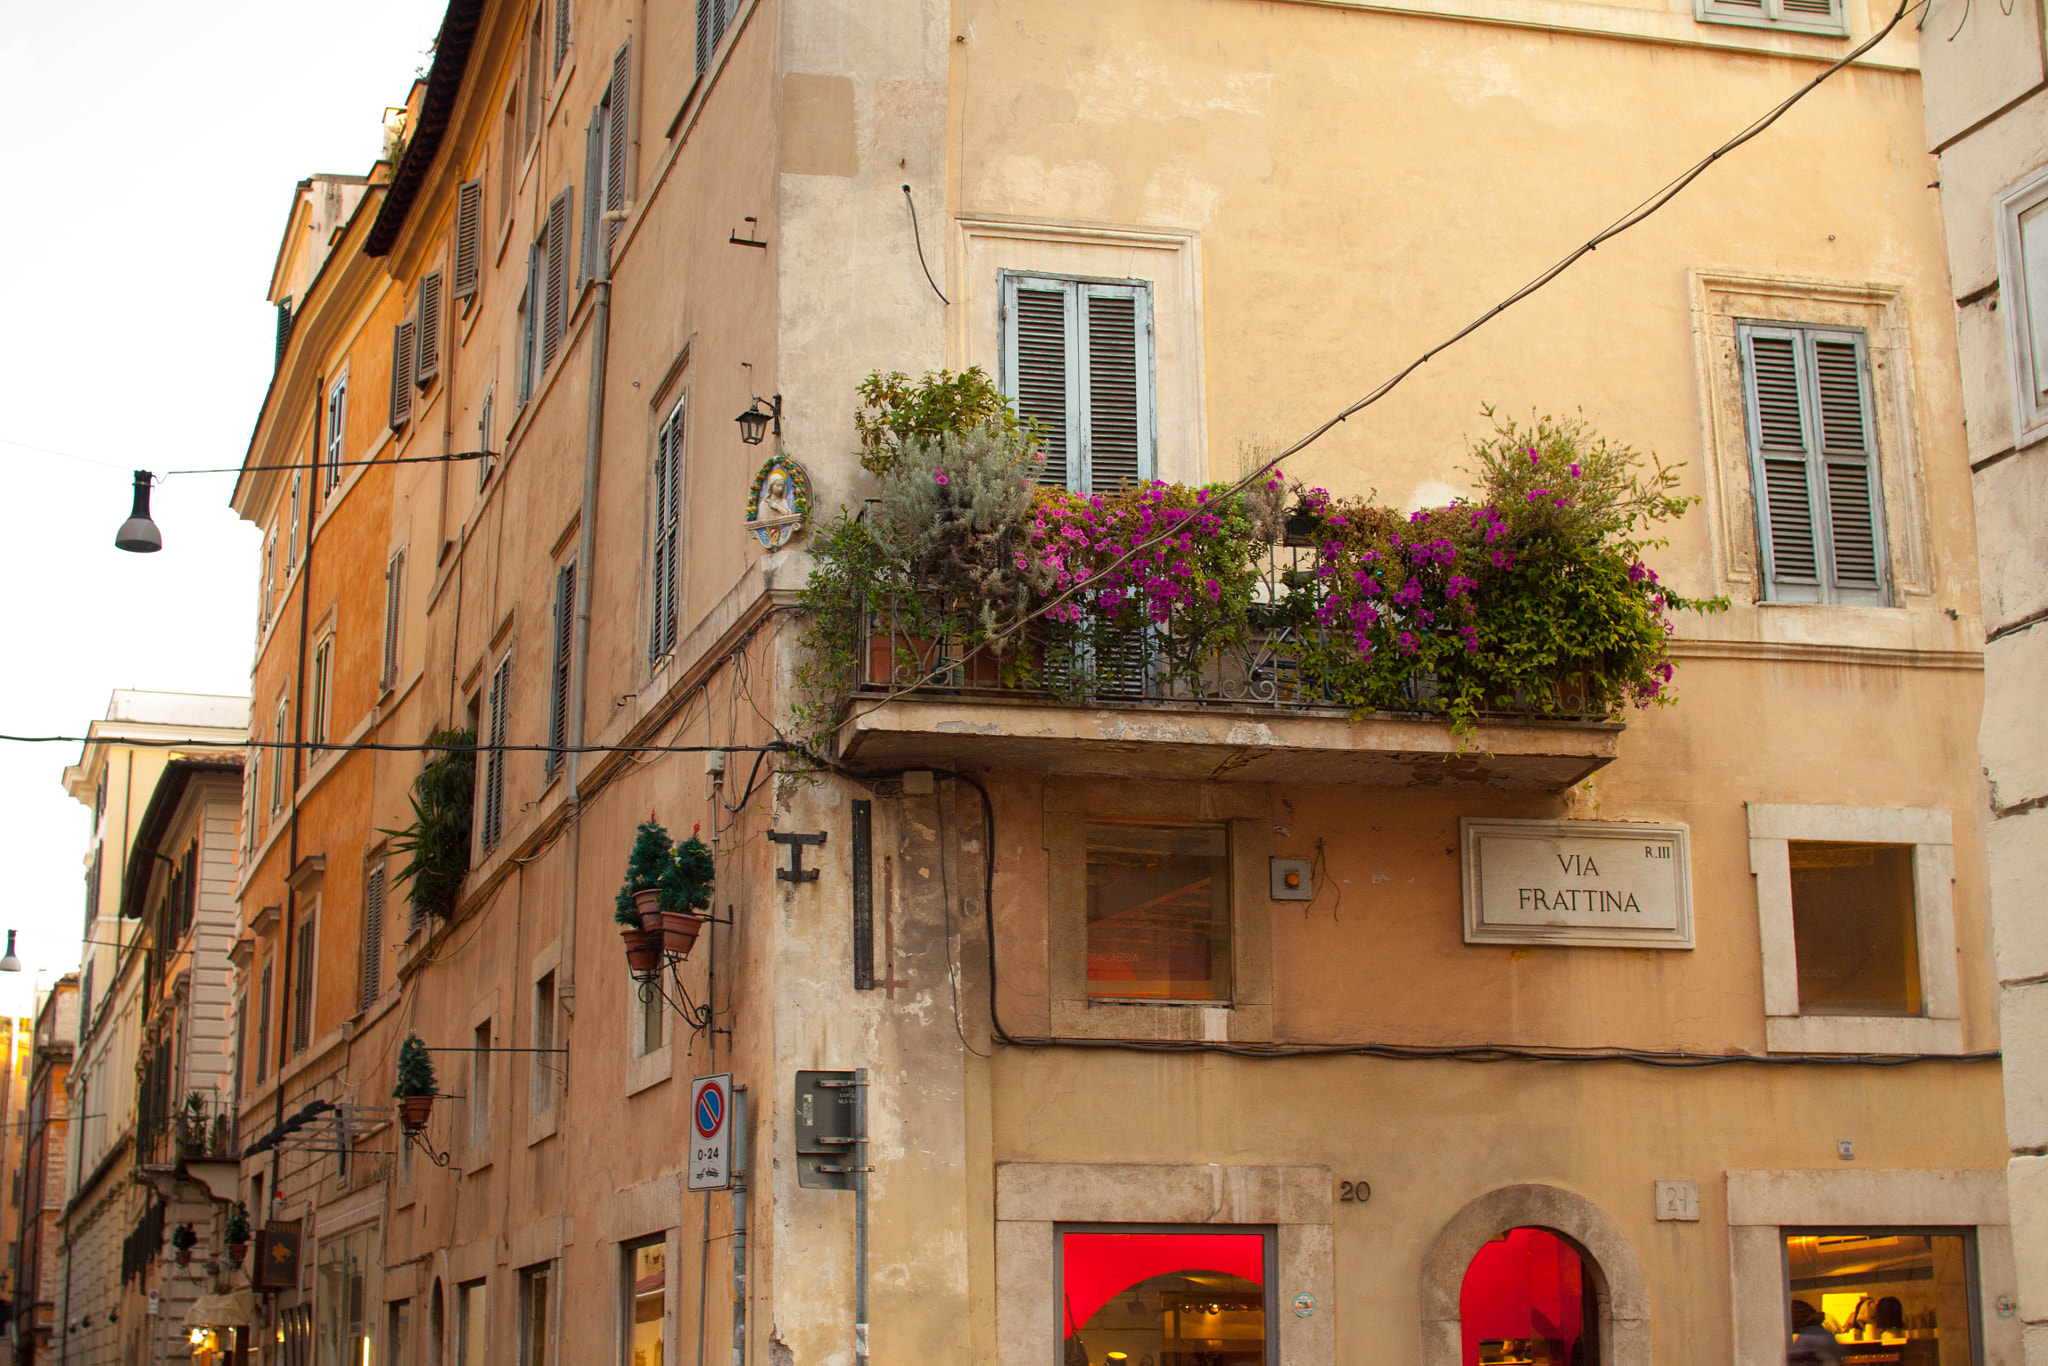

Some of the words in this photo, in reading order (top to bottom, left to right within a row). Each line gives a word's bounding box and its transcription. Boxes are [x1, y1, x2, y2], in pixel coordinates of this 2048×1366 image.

[1645, 846, 1671, 859] R.III
[1557, 854, 1600, 876] VIA
[1518, 888, 1641, 912] FRATTINA
[1340, 1181, 1371, 1202] 20
[1666, 1187, 1687, 1212] 21
